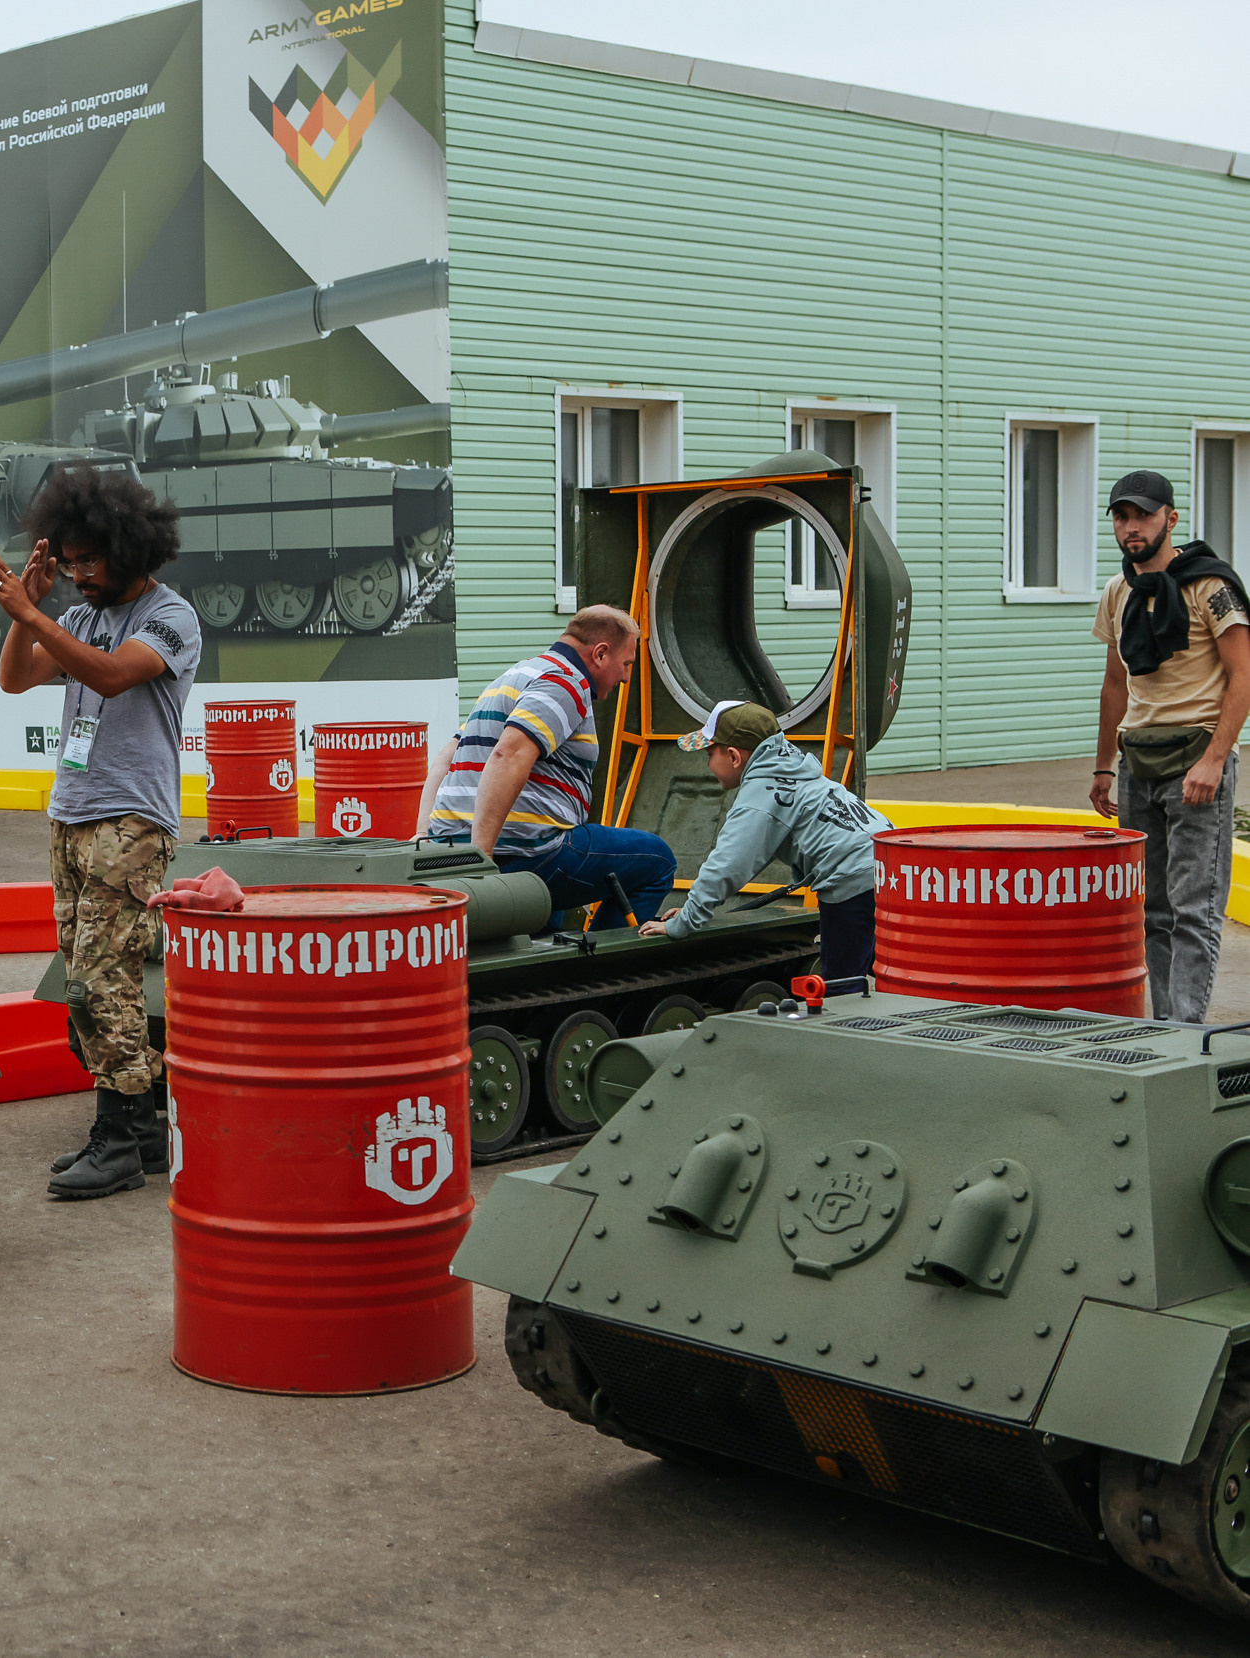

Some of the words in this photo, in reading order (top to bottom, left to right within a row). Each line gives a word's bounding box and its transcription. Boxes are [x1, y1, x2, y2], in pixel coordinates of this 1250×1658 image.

[281, 25, 366, 51] INTERNATIONAL
[22, 99, 68, 125] боевой
[71, 82, 149, 113] подготовки
[8, 117, 85, 150] Российской
[87, 101, 166, 131] Федерации
[180, 736, 205, 751] ВЕ
